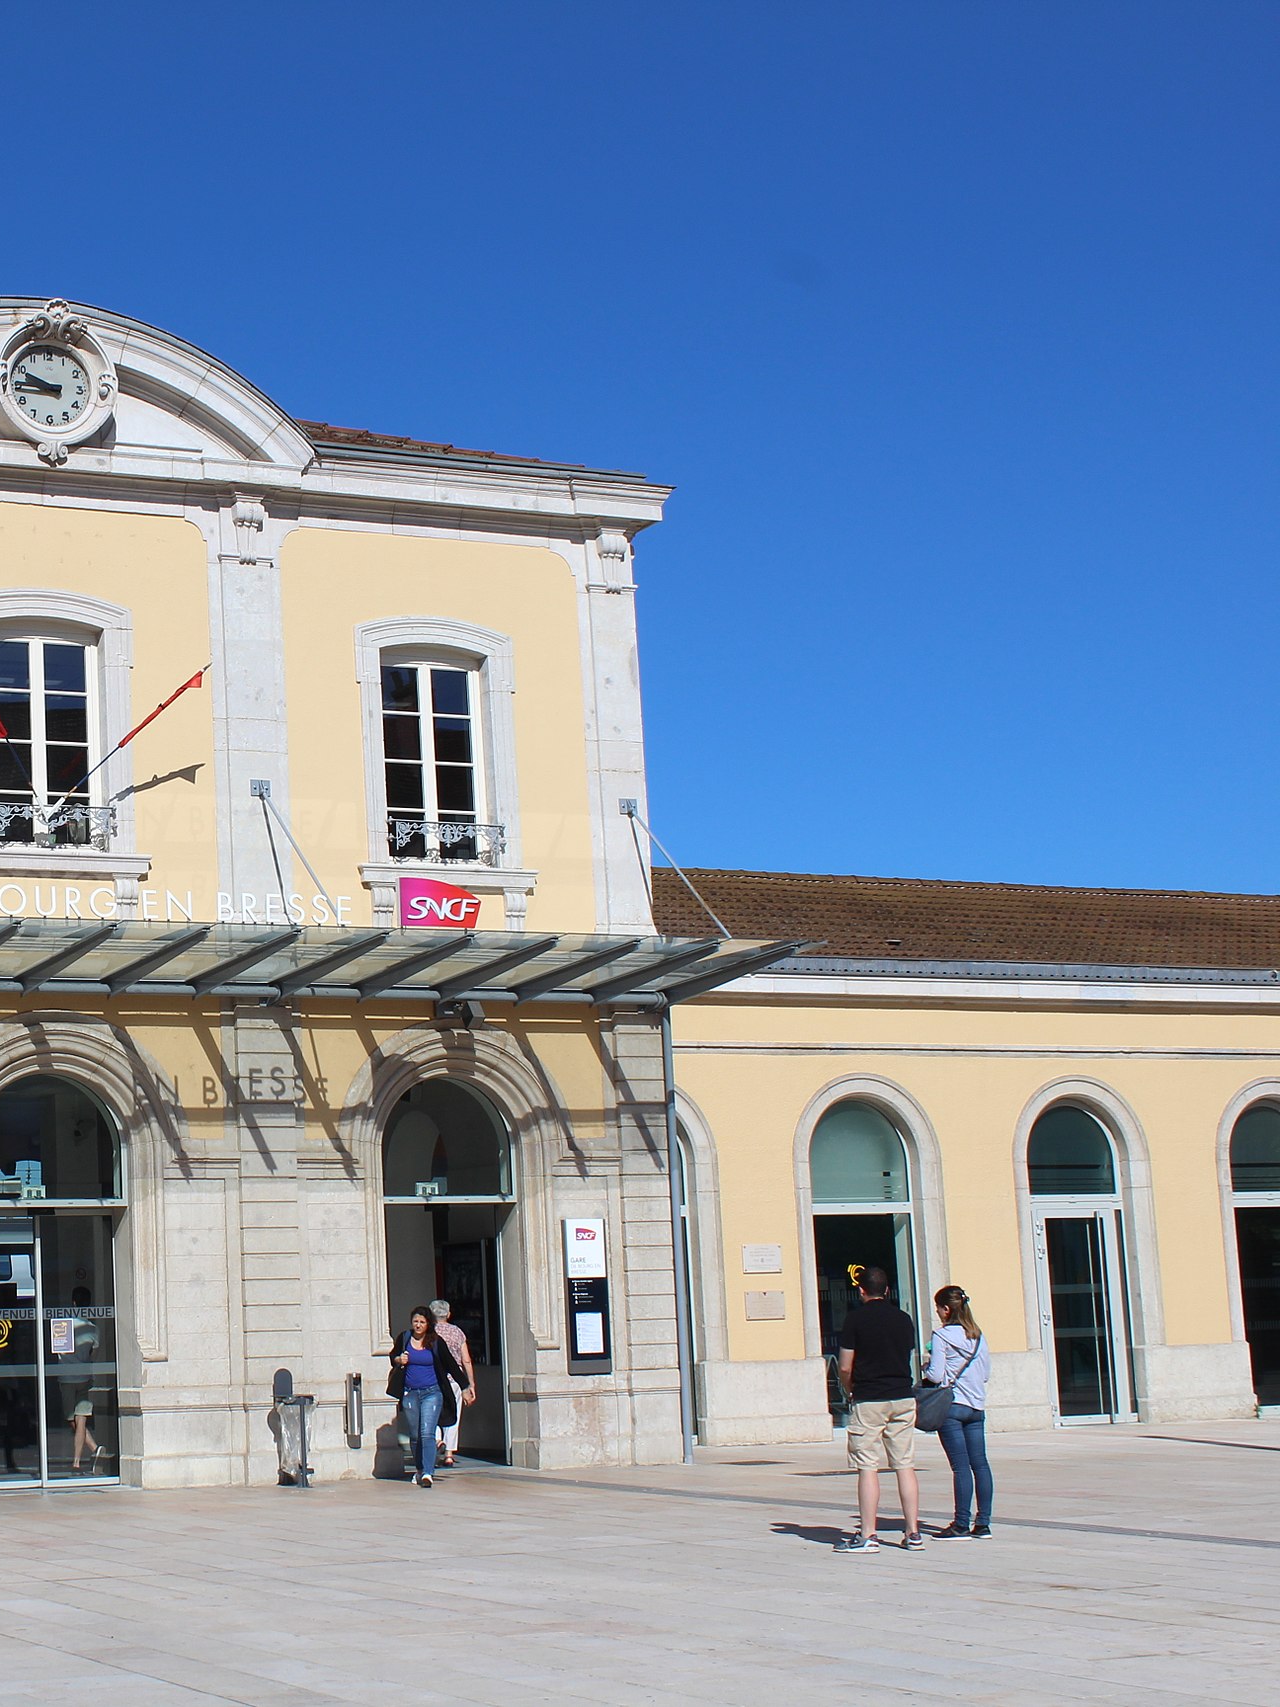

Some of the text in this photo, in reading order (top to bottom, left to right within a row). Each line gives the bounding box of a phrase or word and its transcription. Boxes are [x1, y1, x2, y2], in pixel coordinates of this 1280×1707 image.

[30, 355, 36, 364] 11
[43, 353, 53, 361] 12
[17, 365, 26, 374] 10
[72, 369, 79, 379] 2
[76, 385, 84, 395] 3
[18, 396, 26, 405] 8
[71, 400, 80, 410] 4
[30, 409, 37, 418] 7
[62, 411, 70, 421] 5
[46, 415, 54, 424] 6
[142, 889, 192, 921] EN
[217, 892, 353, 925] BRESSE
[407, 896, 479, 921] SNCF
[576, 1232, 596, 1240] SNCF
[46, 1307, 113, 1319] BIENVENUE
